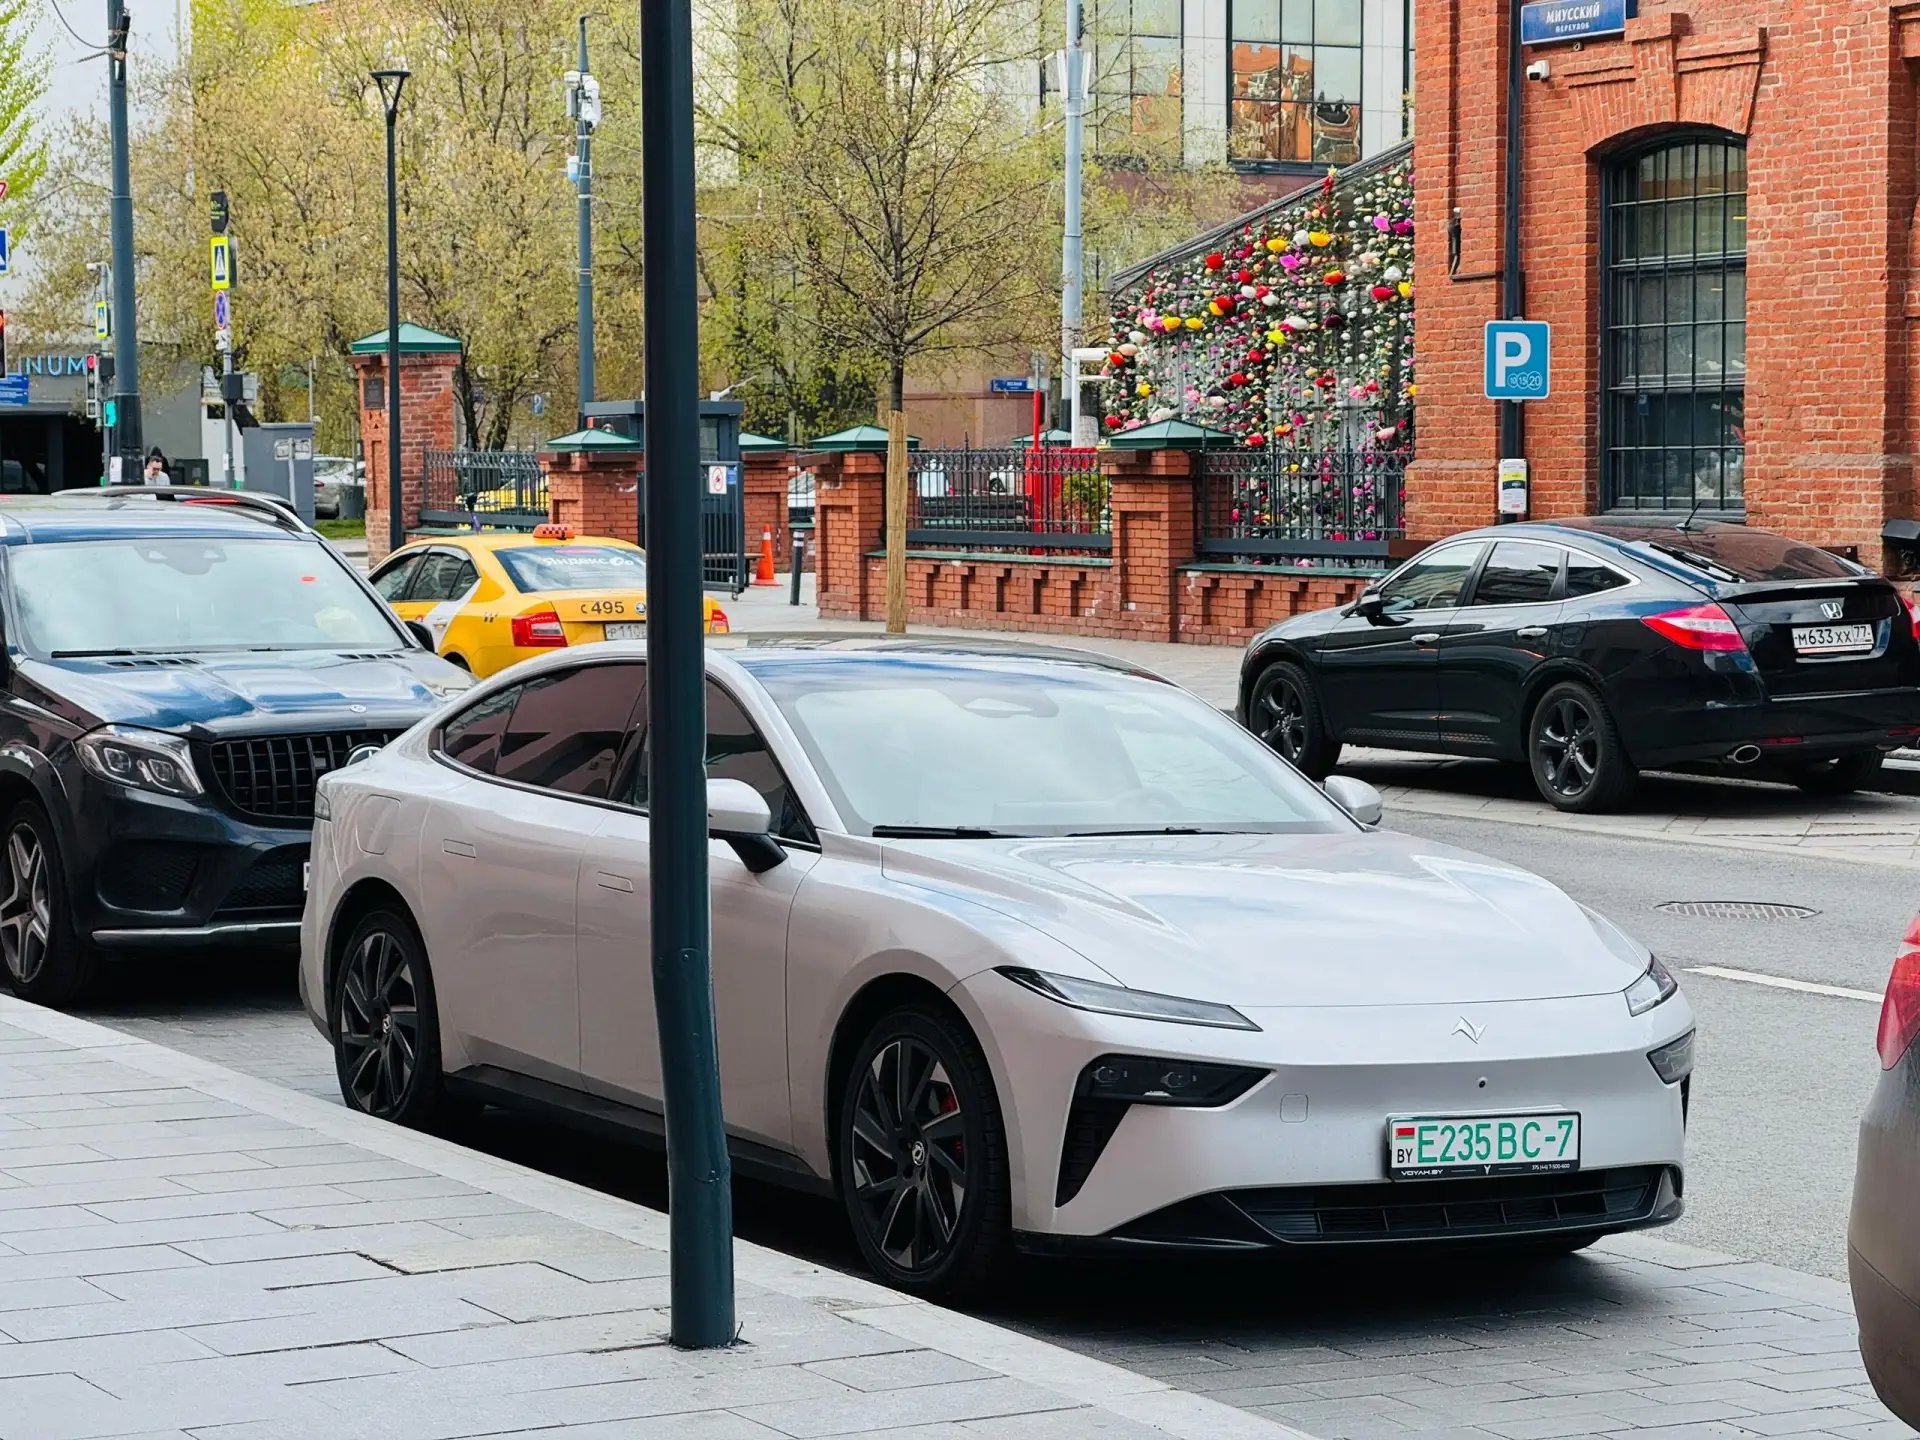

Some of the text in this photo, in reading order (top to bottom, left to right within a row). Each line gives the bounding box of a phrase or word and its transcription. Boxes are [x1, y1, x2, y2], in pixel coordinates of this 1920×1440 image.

[1545, 2, 1601, 24] МИУССКИЙ
[1555, 22, 1590, 33] ПЕРЕУЛОК
[1495, 331, 1531, 387] P
[1529, 375, 1541, 386] 20
[1397, 1148, 1413, 1163] BY
